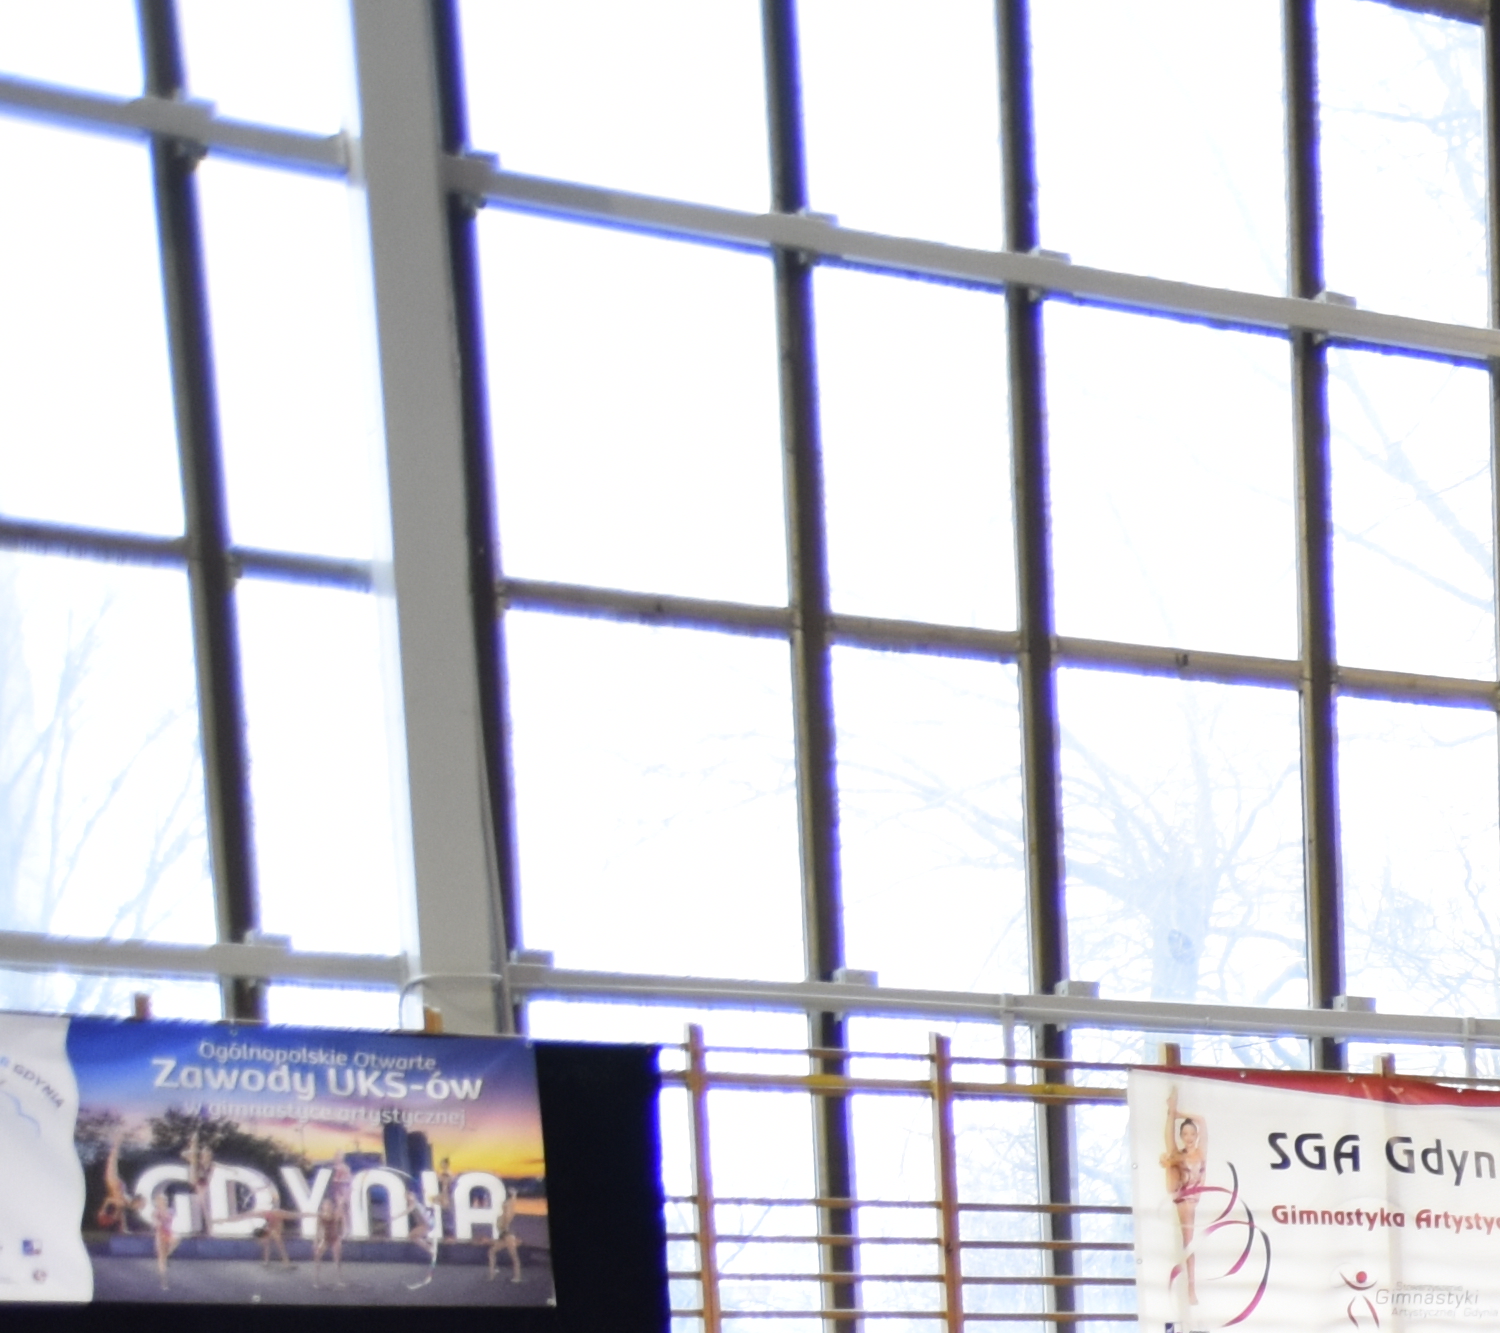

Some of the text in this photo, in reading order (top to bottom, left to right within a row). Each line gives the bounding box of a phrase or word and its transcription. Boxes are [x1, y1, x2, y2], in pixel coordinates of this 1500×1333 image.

[199, 1041, 437, 1073] Ogólnopolskie Otwarte
[151, 1056, 483, 1101] Zawody UKS-ów
[336, 1104, 466, 1129] artystycznej
[1267, 1132, 1361, 1176] SGA
[134, 1163, 504, 1241] GDYNIA
[1271, 1204, 1406, 1232] Gimnastyka
[1375, 1288, 1479, 1309] Gimnastyki
